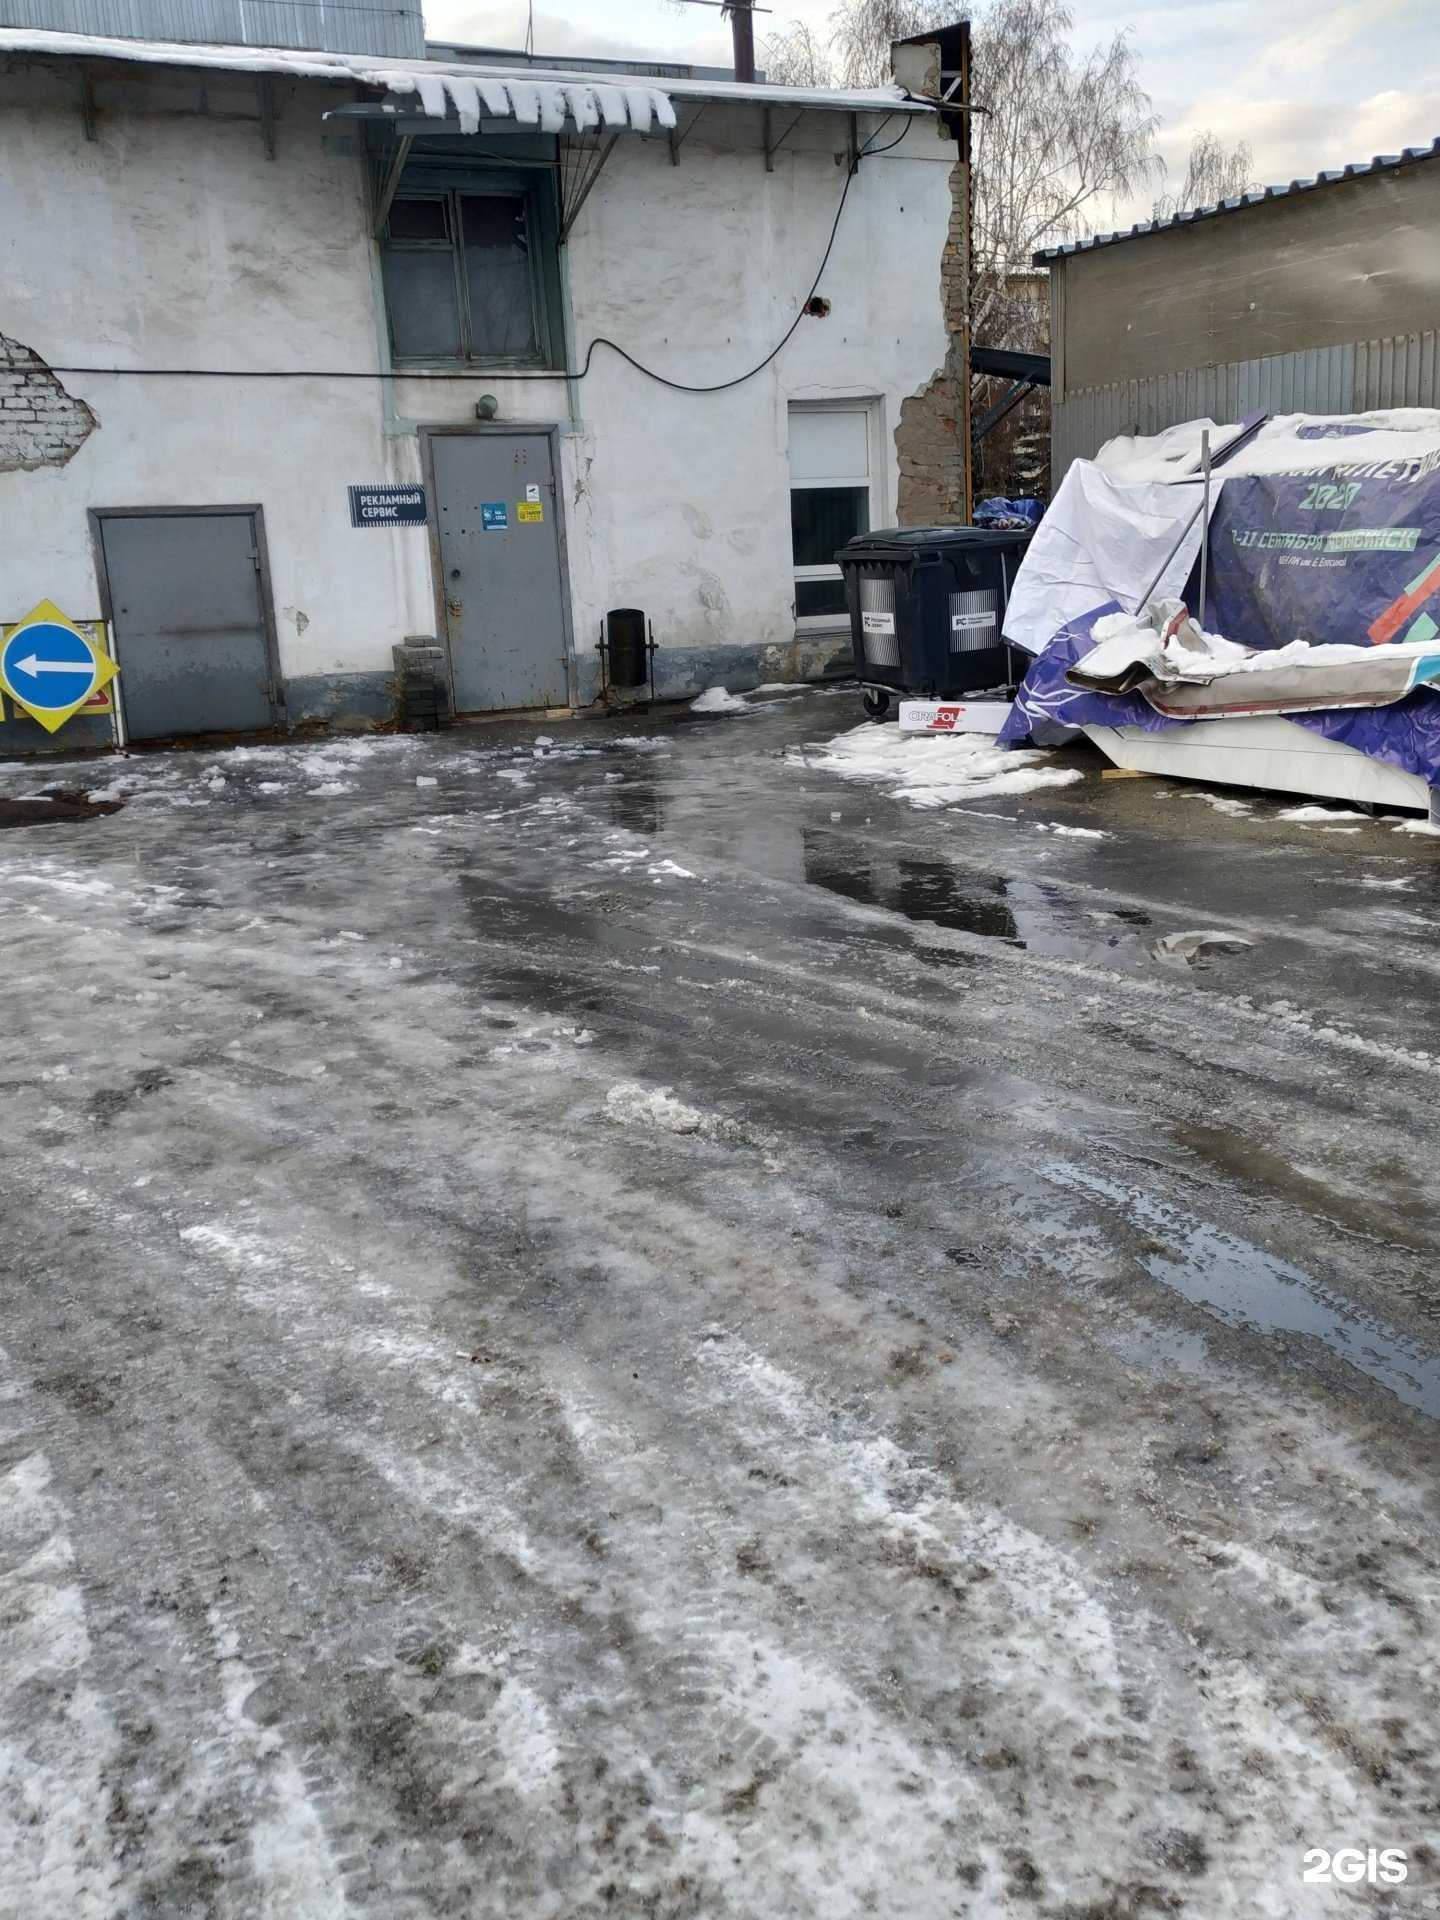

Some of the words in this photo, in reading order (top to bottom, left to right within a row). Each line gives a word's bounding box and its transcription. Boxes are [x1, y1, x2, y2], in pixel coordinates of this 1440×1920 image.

[360, 492, 421, 505] РЕКЛАМНЫЙ
[1298, 482, 1362, 510] 2020
[361, 507, 398, 518] СЕРВИС
[1258, 532, 1325, 551] СЕНТЯБРЯ
[909, 711, 960, 722] ORAFOL
